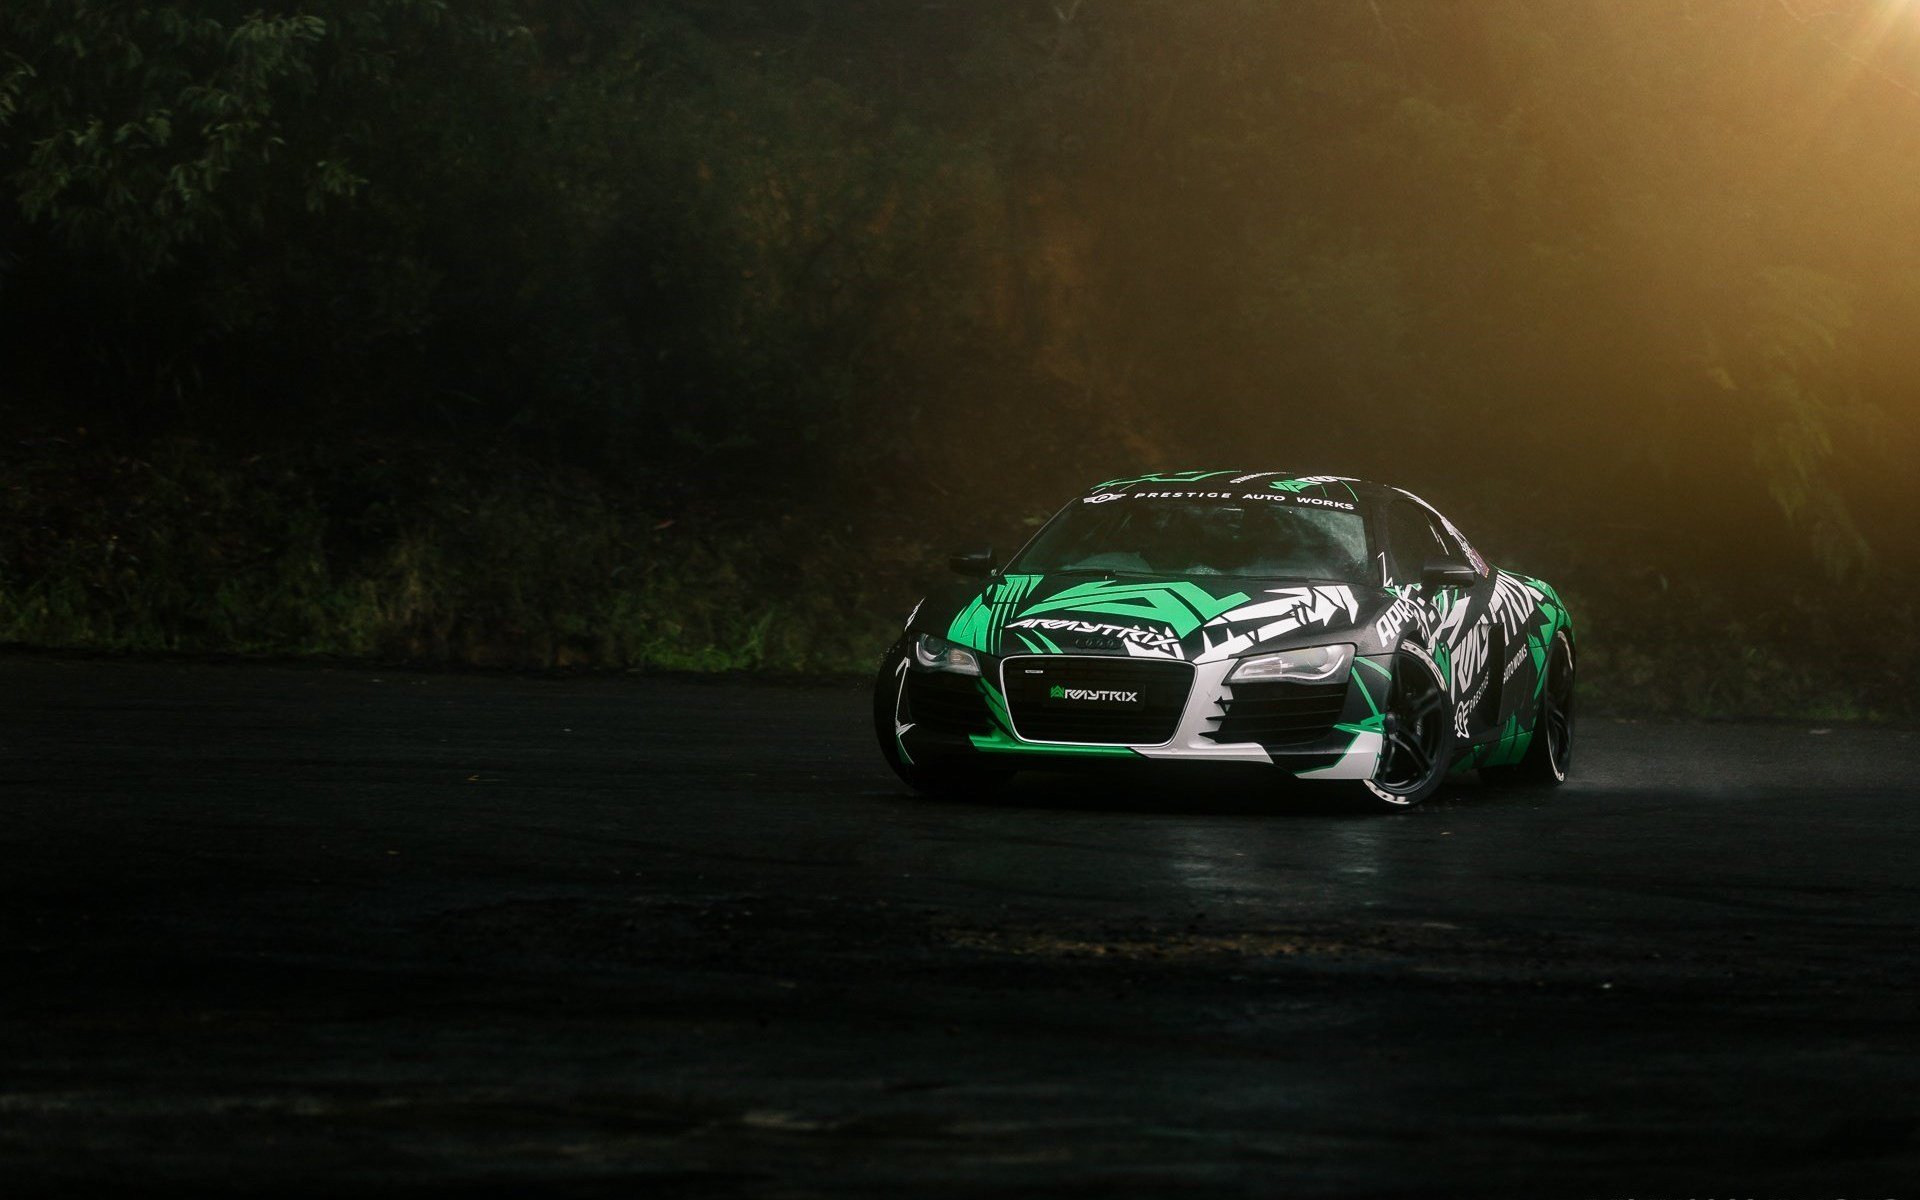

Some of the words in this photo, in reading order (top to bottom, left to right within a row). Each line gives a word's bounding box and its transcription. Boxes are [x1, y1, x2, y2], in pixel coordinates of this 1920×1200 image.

[1134, 491, 1232, 499] PRESTIGE
[1242, 493, 1286, 501] AUTO
[1296, 496, 1354, 510] WORKS
